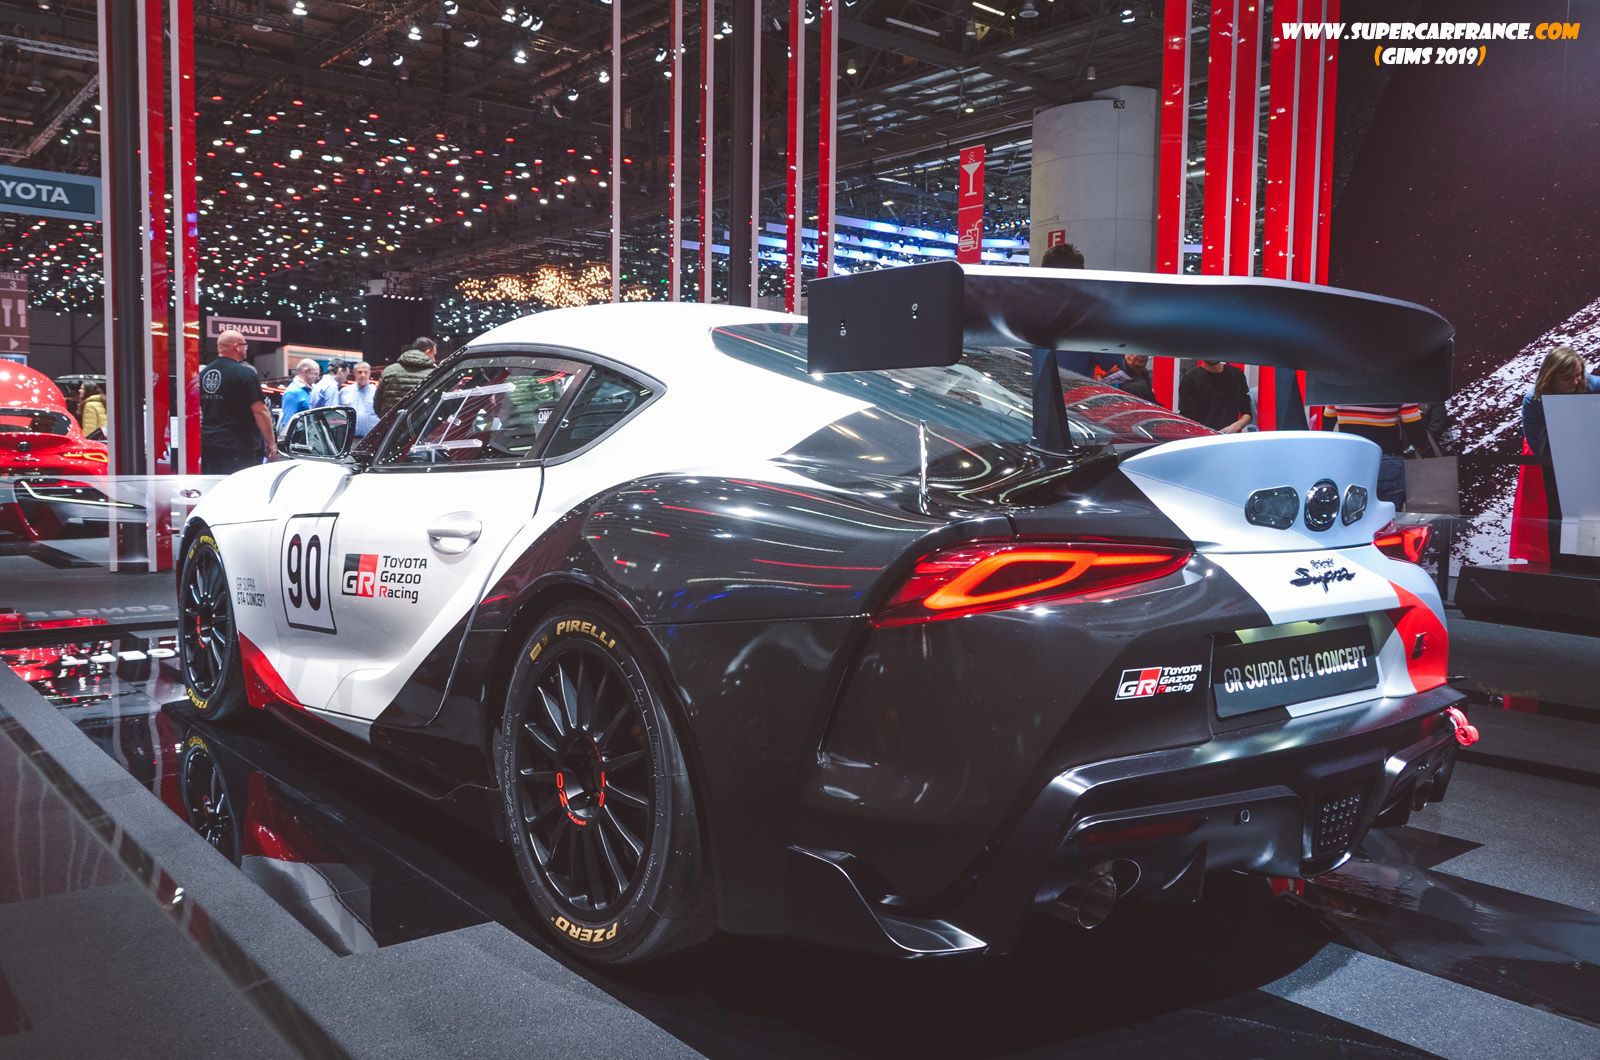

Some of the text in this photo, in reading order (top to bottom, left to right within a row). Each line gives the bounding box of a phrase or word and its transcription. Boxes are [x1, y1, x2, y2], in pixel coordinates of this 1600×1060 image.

[0, 179, 70, 204] YOTA
[0, 272, 26, 281] HALLE
[9, 281, 17, 290] 3
[218, 323, 271, 335] RENAULT
[538, 411, 553, 422] OM
[383, 555, 428, 570] TOYOTA
[287, 533, 322, 612] 90
[380, 571, 422, 585] GAZOO
[343, 570, 376, 597] GR
[1289, 567, 1356, 594] Supra
[246, 592, 265, 608] CONCEPT
[378, 585, 419, 604] Racing
[556, 619, 616, 649] PIRELLI
[1163, 664, 1202, 676] TOYOTA
[1224, 645, 1368, 693] GR SUPRA GT4 CONCEPT
[1159, 674, 1197, 685] GAZOO
[1156, 683, 1194, 693] Racing
